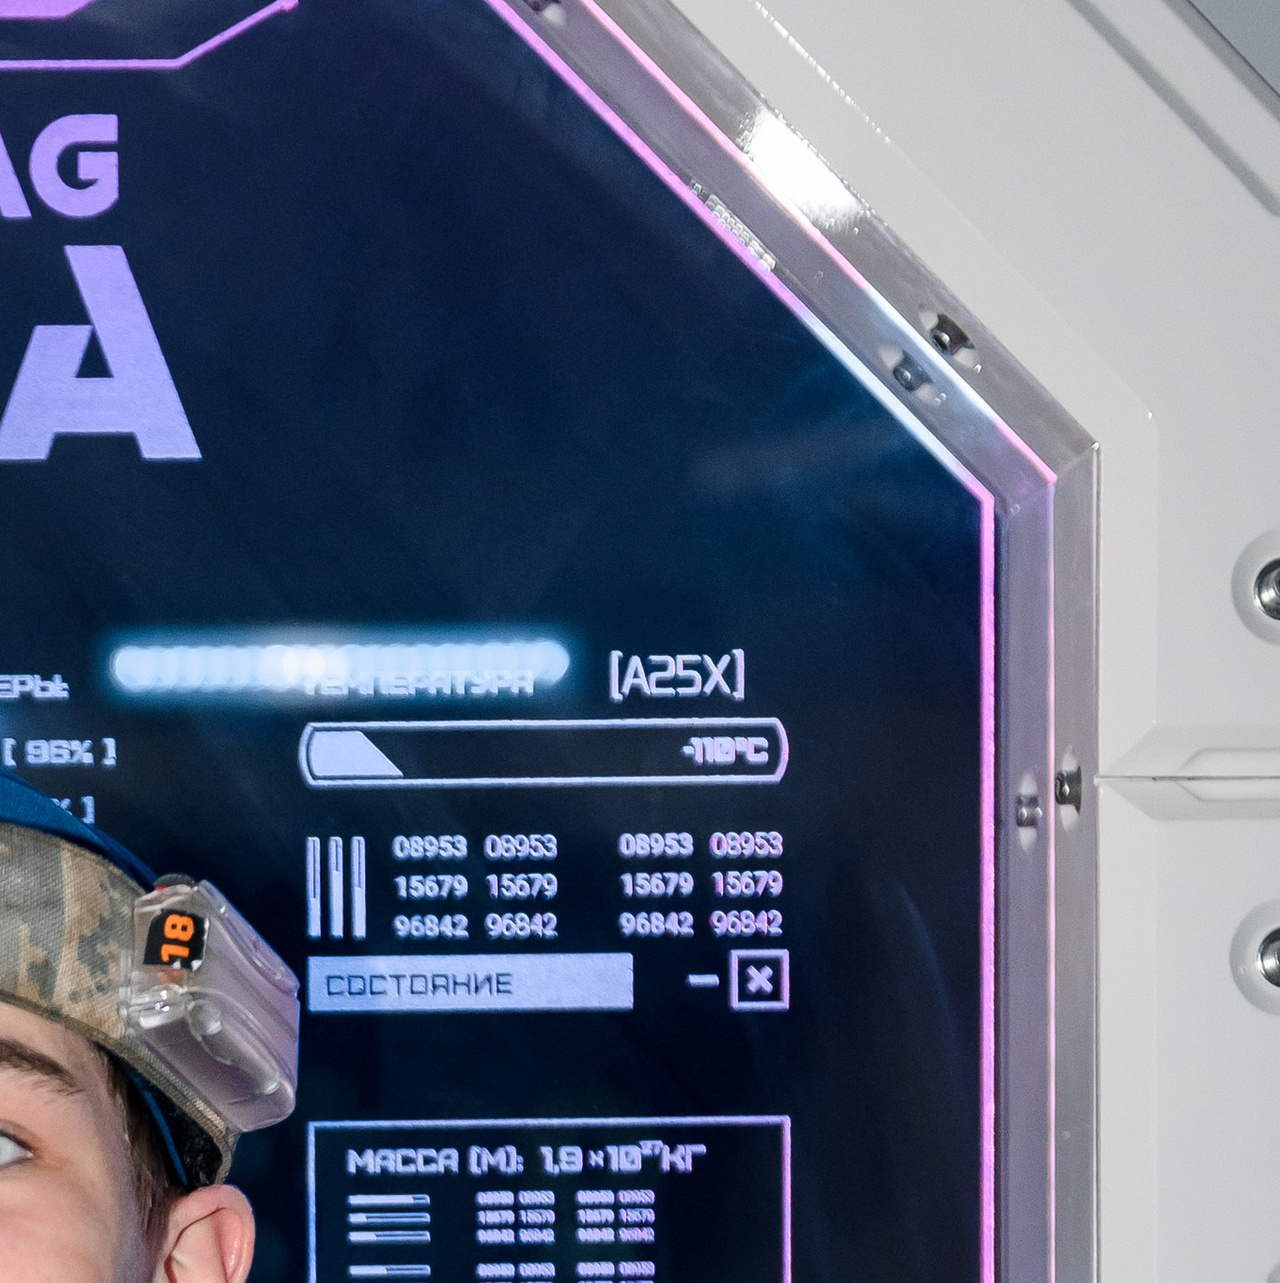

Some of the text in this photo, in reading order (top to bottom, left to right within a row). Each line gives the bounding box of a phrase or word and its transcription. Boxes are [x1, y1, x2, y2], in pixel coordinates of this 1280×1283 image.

[610, 649, 745, 701] [A25X]
[393, 834, 558, 861] 08953 08953
[618, 831, 784, 859] 08953 08953
[393, 873, 559, 900] 15679 15679
[618, 870, 784, 898] 15679 15679
[393, 913, 559, 940] 96842 96842
[618, 909, 784, 938] 96842 96842
[161, 913, 194, 963] 18
[326, 973, 514, 997] СОСТОЯНИЕ
[346, 1148, 460, 1176] МАССА
